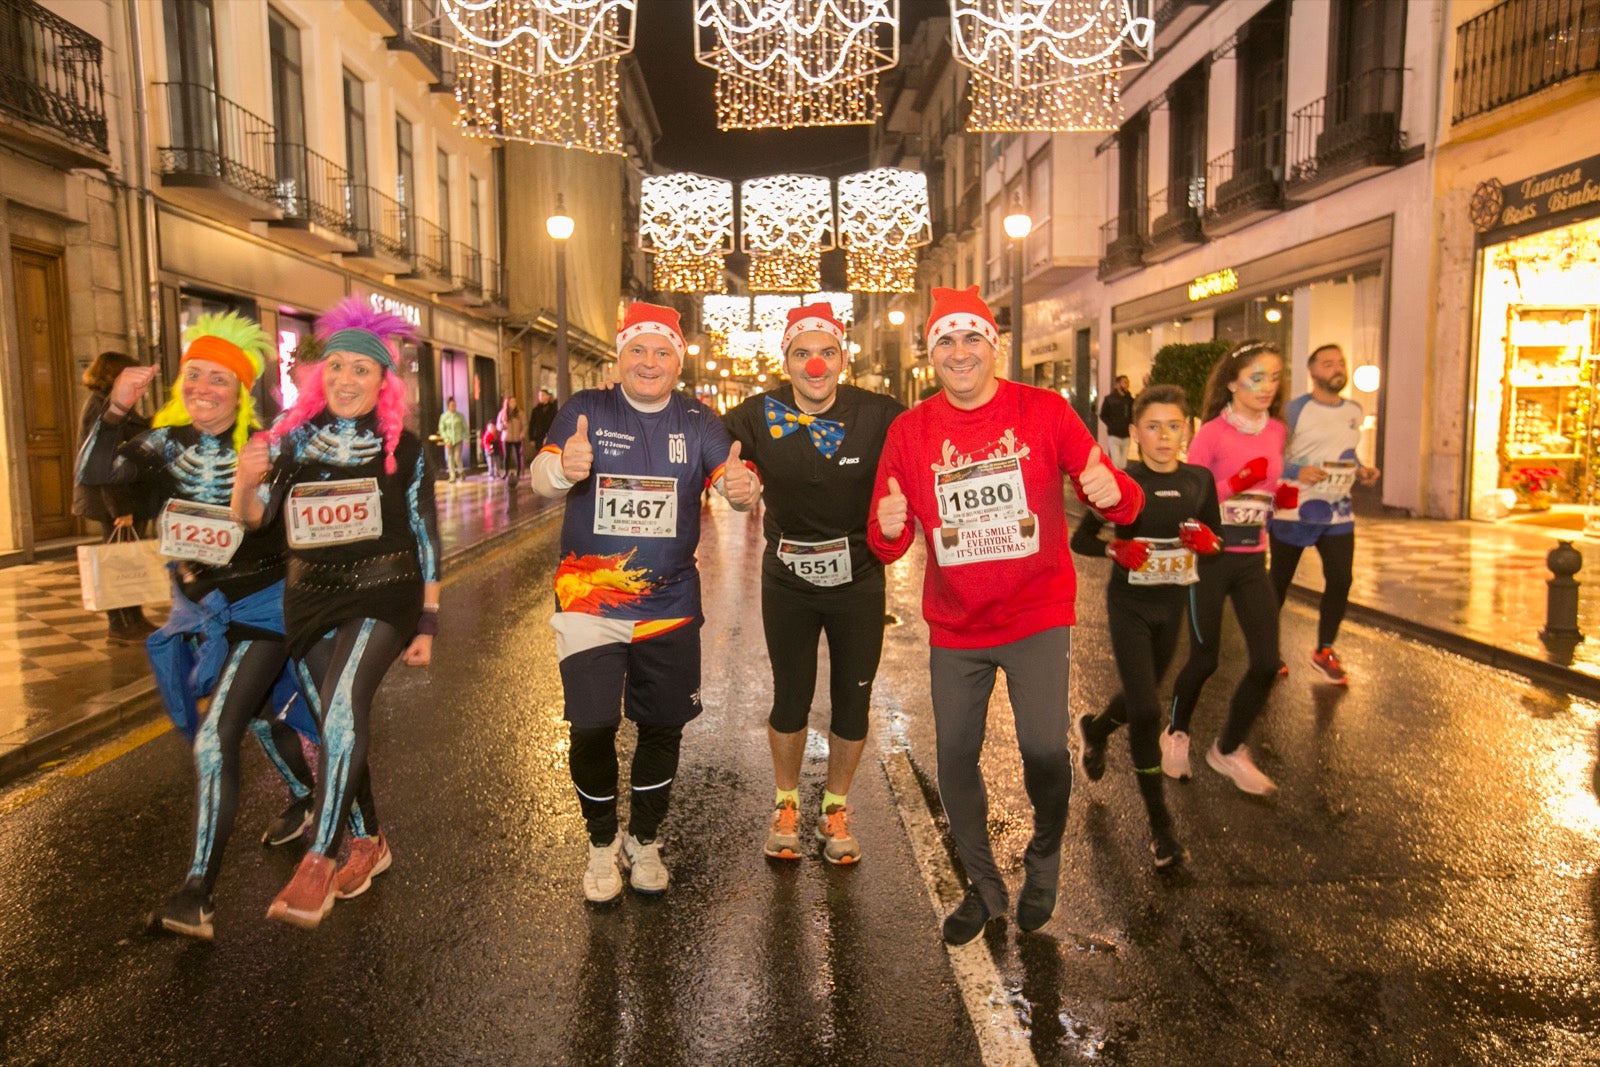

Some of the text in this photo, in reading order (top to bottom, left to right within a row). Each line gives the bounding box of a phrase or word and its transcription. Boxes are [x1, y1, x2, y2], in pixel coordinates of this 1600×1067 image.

[1520, 168, 1582, 199] Taracea
[603, 429, 635, 442] Santander
[668, 438, 688, 464] 091
[949, 483, 1013, 512] 1880
[301, 502, 369, 526] 1005
[606, 498, 666, 519] 1467
[170, 522, 232, 548] 1230
[961, 525, 1018, 540] FAKE SMILES
[967, 535, 1014, 548] EVERYONE
[956, 543, 1026, 558] IT'S CHRISTMAS
[786, 558, 838, 575] 1551
[1146, 556, 1186, 573] 313
